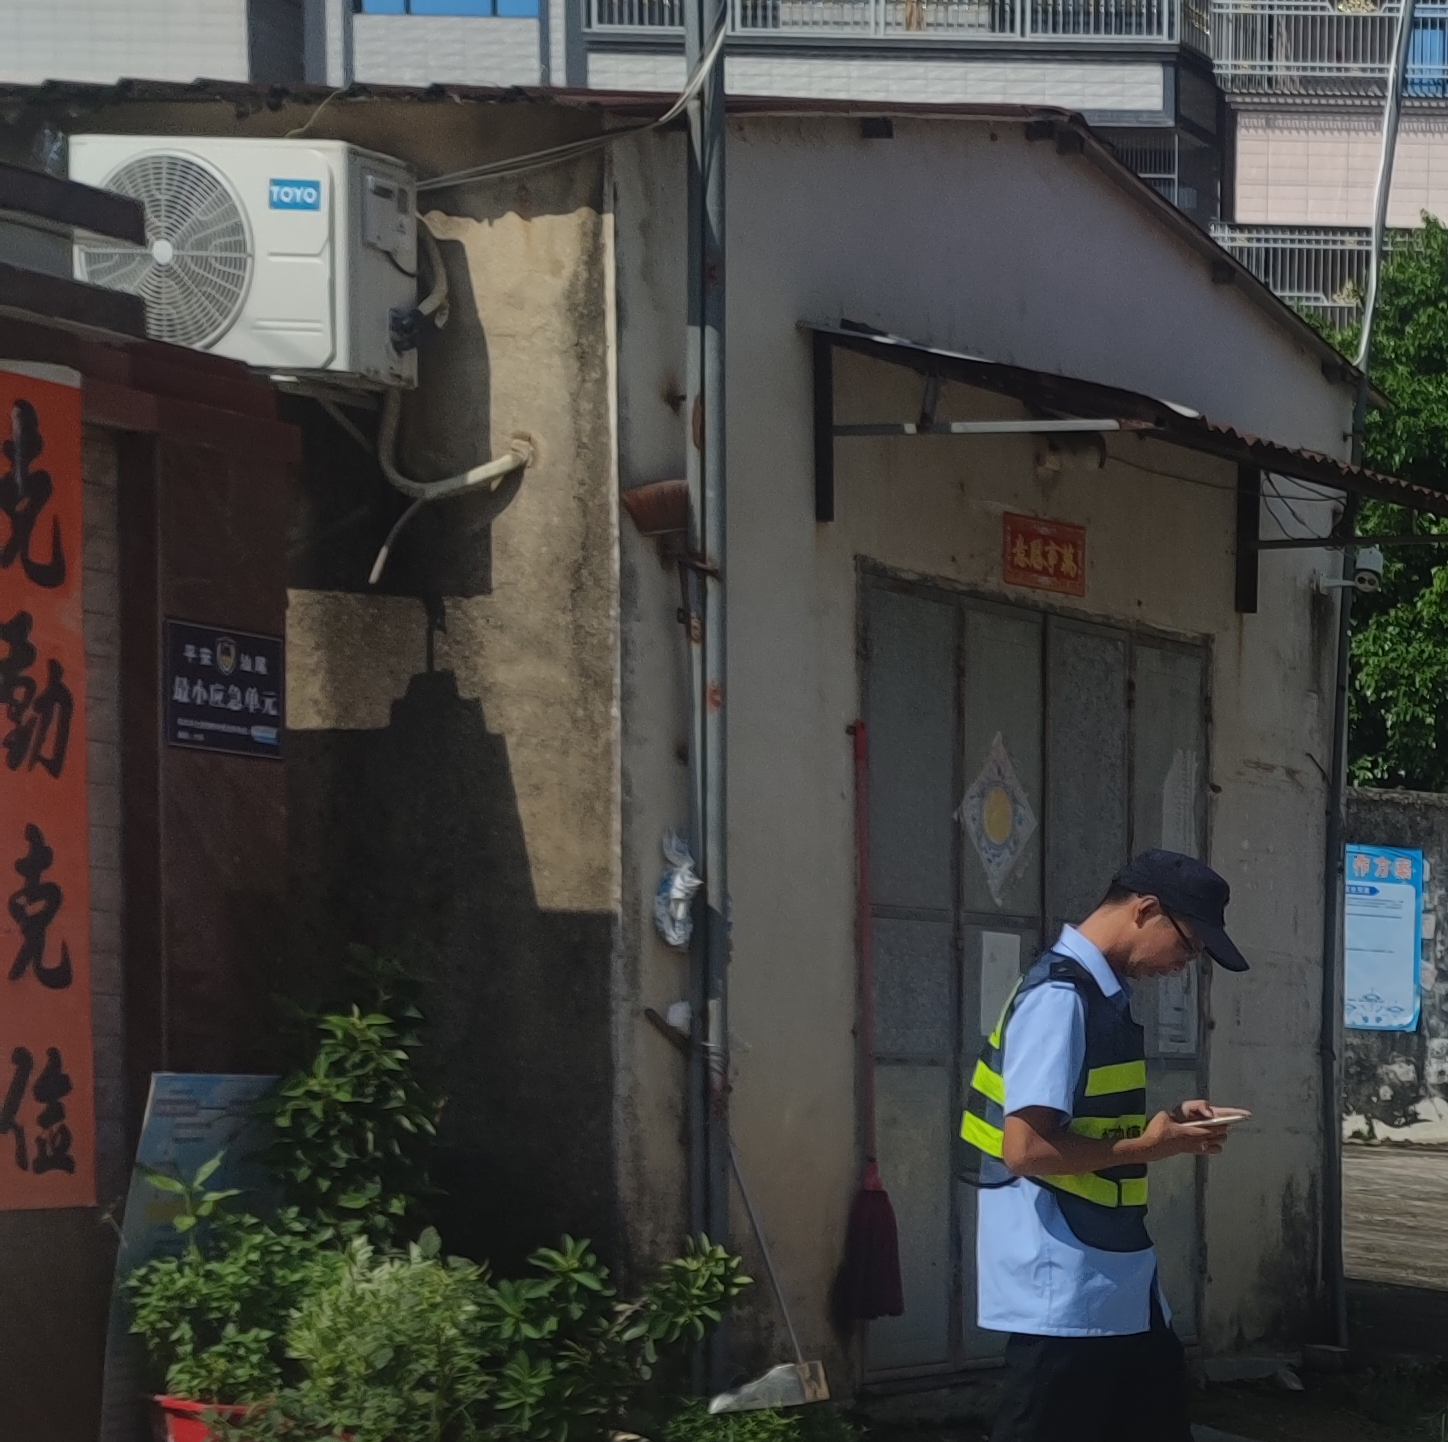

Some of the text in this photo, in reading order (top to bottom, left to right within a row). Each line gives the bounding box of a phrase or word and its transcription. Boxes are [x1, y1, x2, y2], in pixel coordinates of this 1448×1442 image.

[270, 185, 318, 204] TOYO
[172, 674, 279, 717] 最小应急单元
